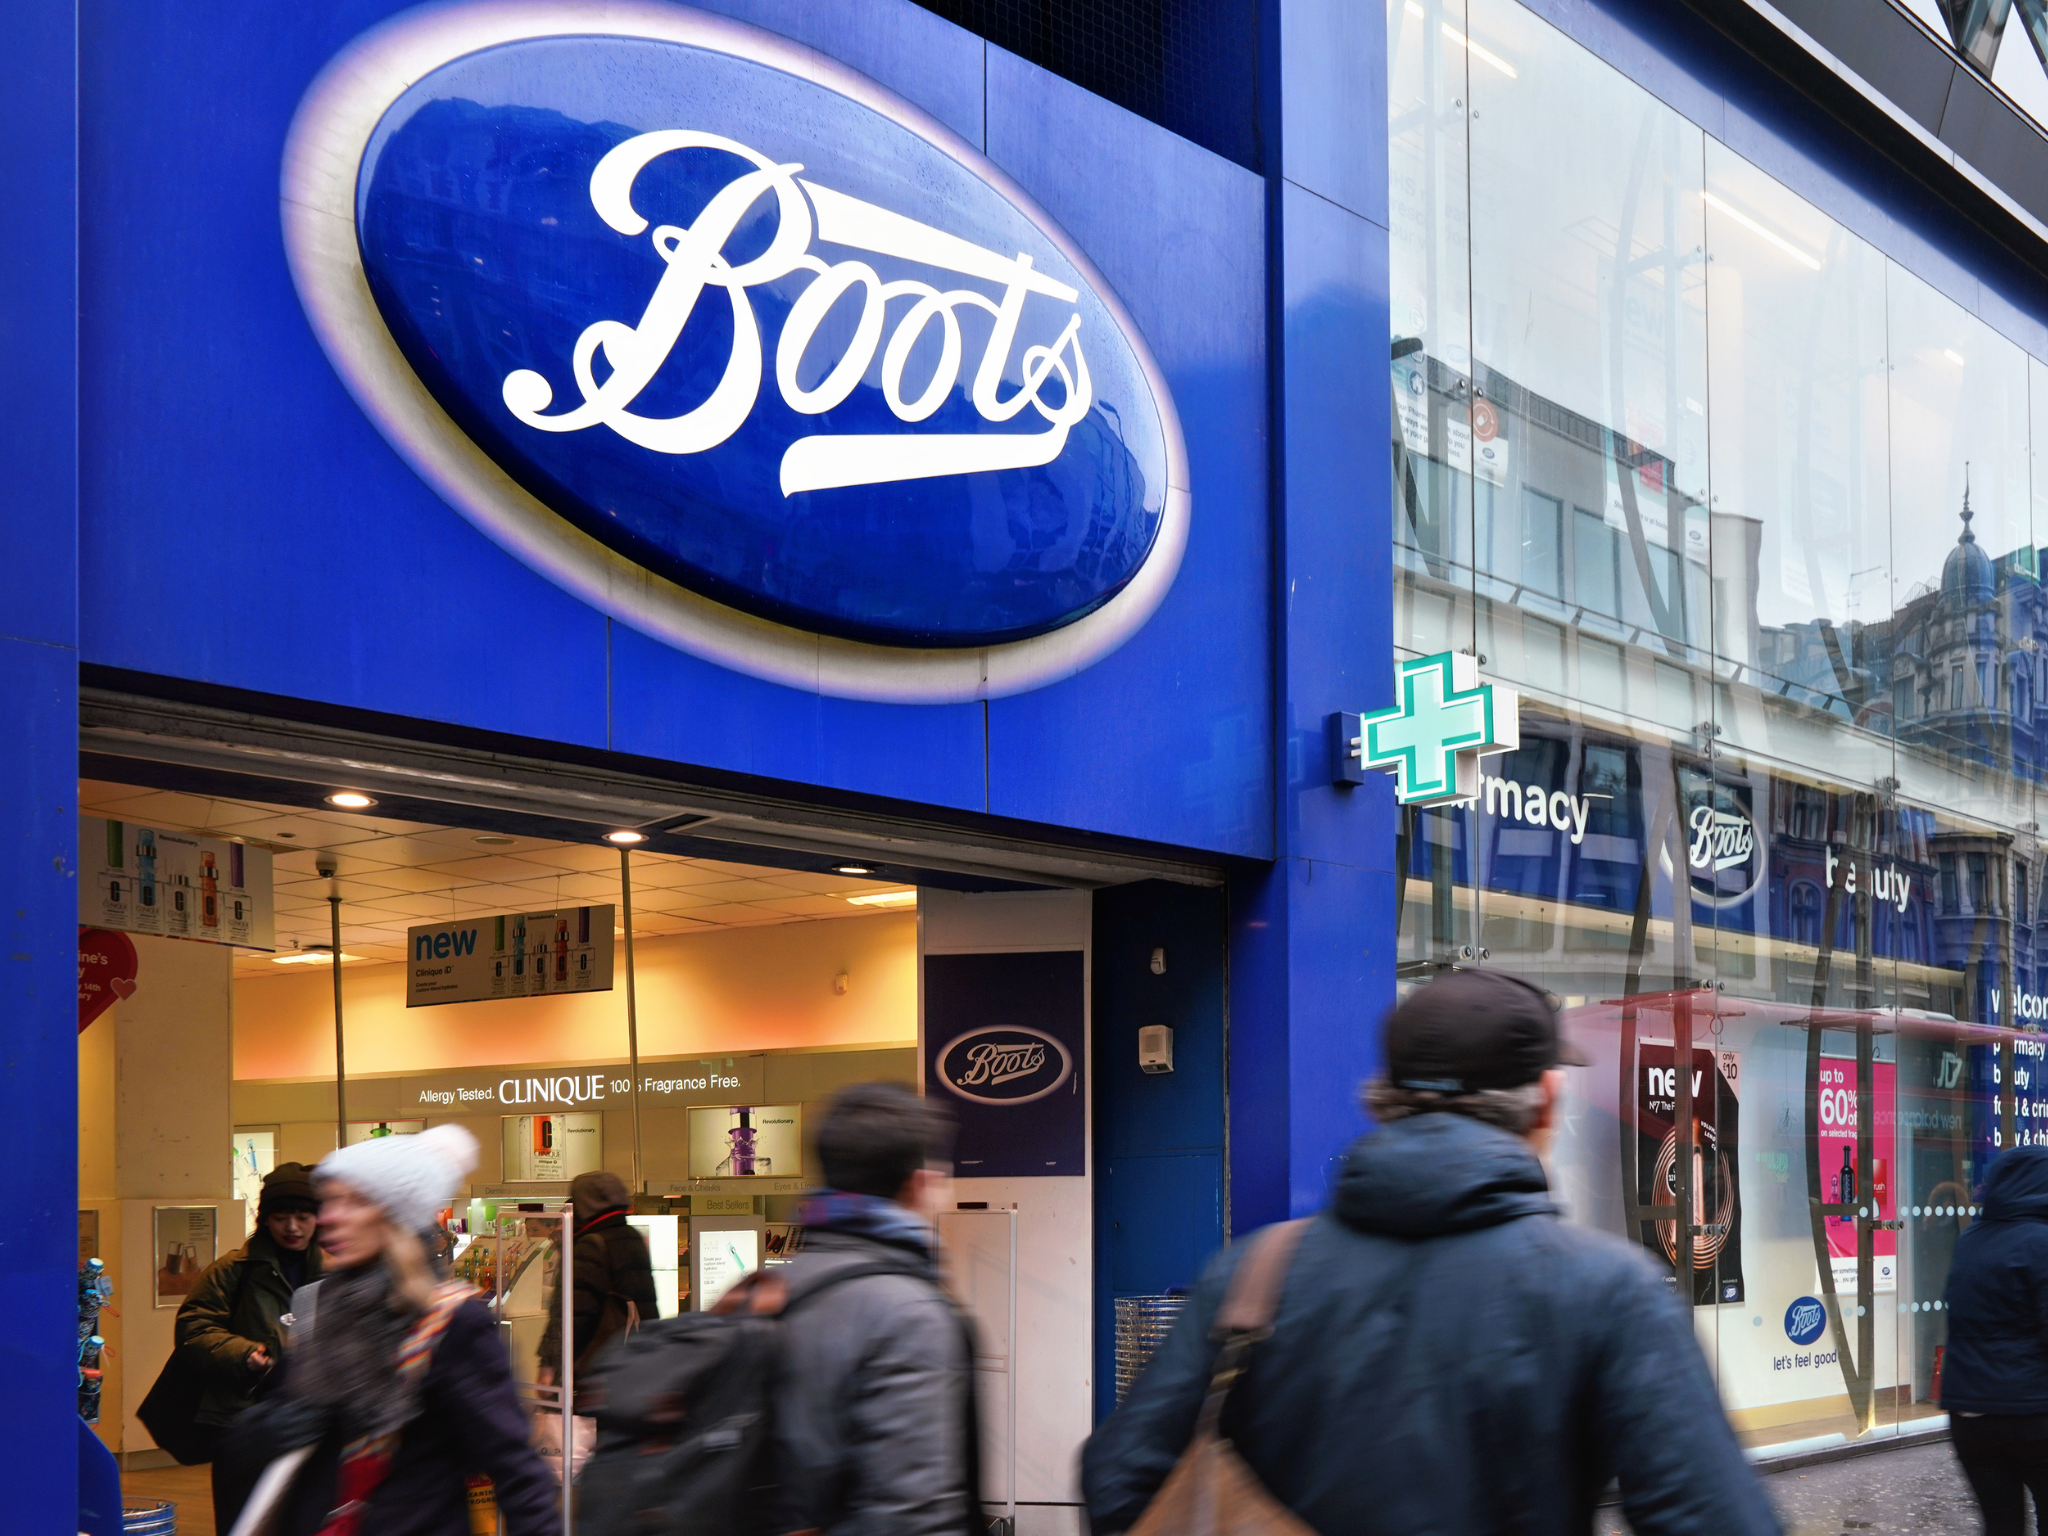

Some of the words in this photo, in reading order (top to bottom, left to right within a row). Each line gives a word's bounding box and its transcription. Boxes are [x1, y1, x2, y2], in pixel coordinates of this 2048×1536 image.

[502, 129, 1093, 499] Boots
[1689, 805, 1754, 872] Boots
[416, 929, 478, 961] new
[415, 967, 442, 977] Clinique
[957, 1042, 1046, 1086] Boots
[1722, 1051, 1735, 1062] only
[1820, 1069, 1832, 1085] up
[1834, 1068, 1844, 1083] to
[419, 1089, 455, 1104] Allergy
[457, 1087, 495, 1101] Tested.
[499, 1074, 606, 1106] CLINIQUE
[645, 1076, 707, 1093] Fragrance
[710, 1074, 741, 1089] Free.
[1661, 1101, 1671, 1111] The
[2021, 1098, 2029, 1117] &
[1829, 1129, 1847, 1138] selected
[2023, 1128, 2031, 1146] &
[669, 1184, 687, 1193] Face
[687, 1184, 694, 1192] &
[694, 1183, 721, 1192] Cheeks
[774, 1181, 792, 1192] Eyes
[793, 1182, 799, 1190] &
[706, 1200, 724, 1210] Best
[726, 1199, 750, 1210] Sellers
[1788, 1304, 1821, 1337] Boots
[1773, 1355, 1792, 1371] let's
[1795, 1352, 1811, 1368] feel
[1814, 1348, 1837, 1369] good
